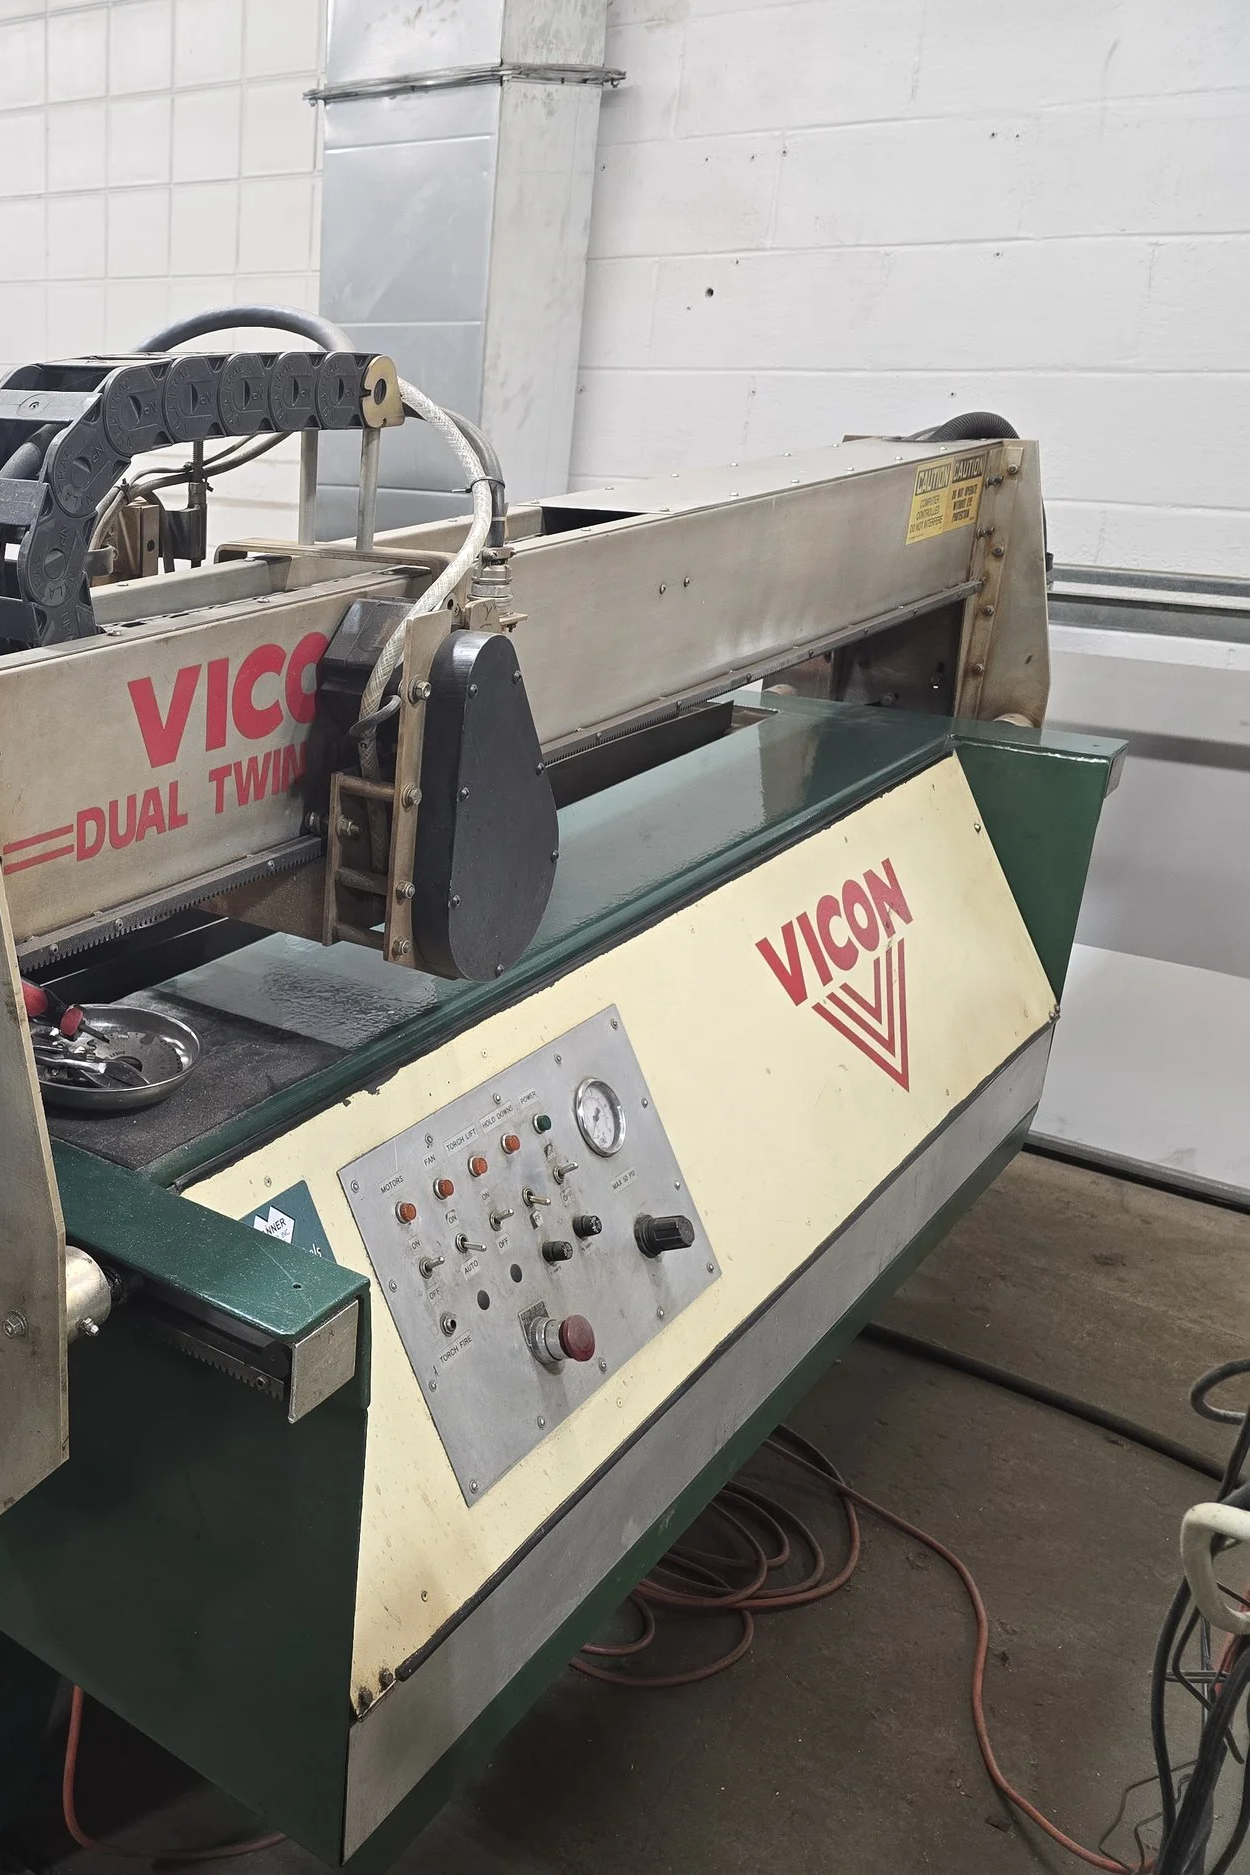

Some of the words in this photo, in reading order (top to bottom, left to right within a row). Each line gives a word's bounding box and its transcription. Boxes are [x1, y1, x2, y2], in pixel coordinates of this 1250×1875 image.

[954, 459, 982, 479] CAUTION
[918, 466, 949, 494] CAUTION
[920, 495, 940, 509] COMPUTER
[916, 506, 940, 521] CONTROLLED
[910, 524, 915, 534] DO
[127, 631, 331, 768] VICO
[76, 780, 188, 862] DUAL
[208, 740, 308, 816] TWIN
[755, 858, 913, 1007] VICON
[520, 1091, 537, 1105] POWER
[482, 1116, 496, 1129] HOLD
[497, 1105, 514, 1120] DOWNS
[446, 1137, 465, 1152] TORCH
[465, 1128, 478, 1142] LIFT
[424, 1155, 436, 1167] FAN
[381, 1176, 404, 1195] MOTORS
[612, 1179, 623, 1190] MAX
[482, 1191, 490, 1200] ON
[262, 1217, 287, 1235] NNER
[448, 1214, 458, 1224] ON
[411, 1240, 420, 1250] ON
[498, 1237, 509, 1248] OFF
[464, 1260, 479, 1275] AUTO
[429, 1289, 441, 1300] OFF
[440, 1346, 460, 1364] TORCH
[459, 1334, 473, 1349] FIRE
